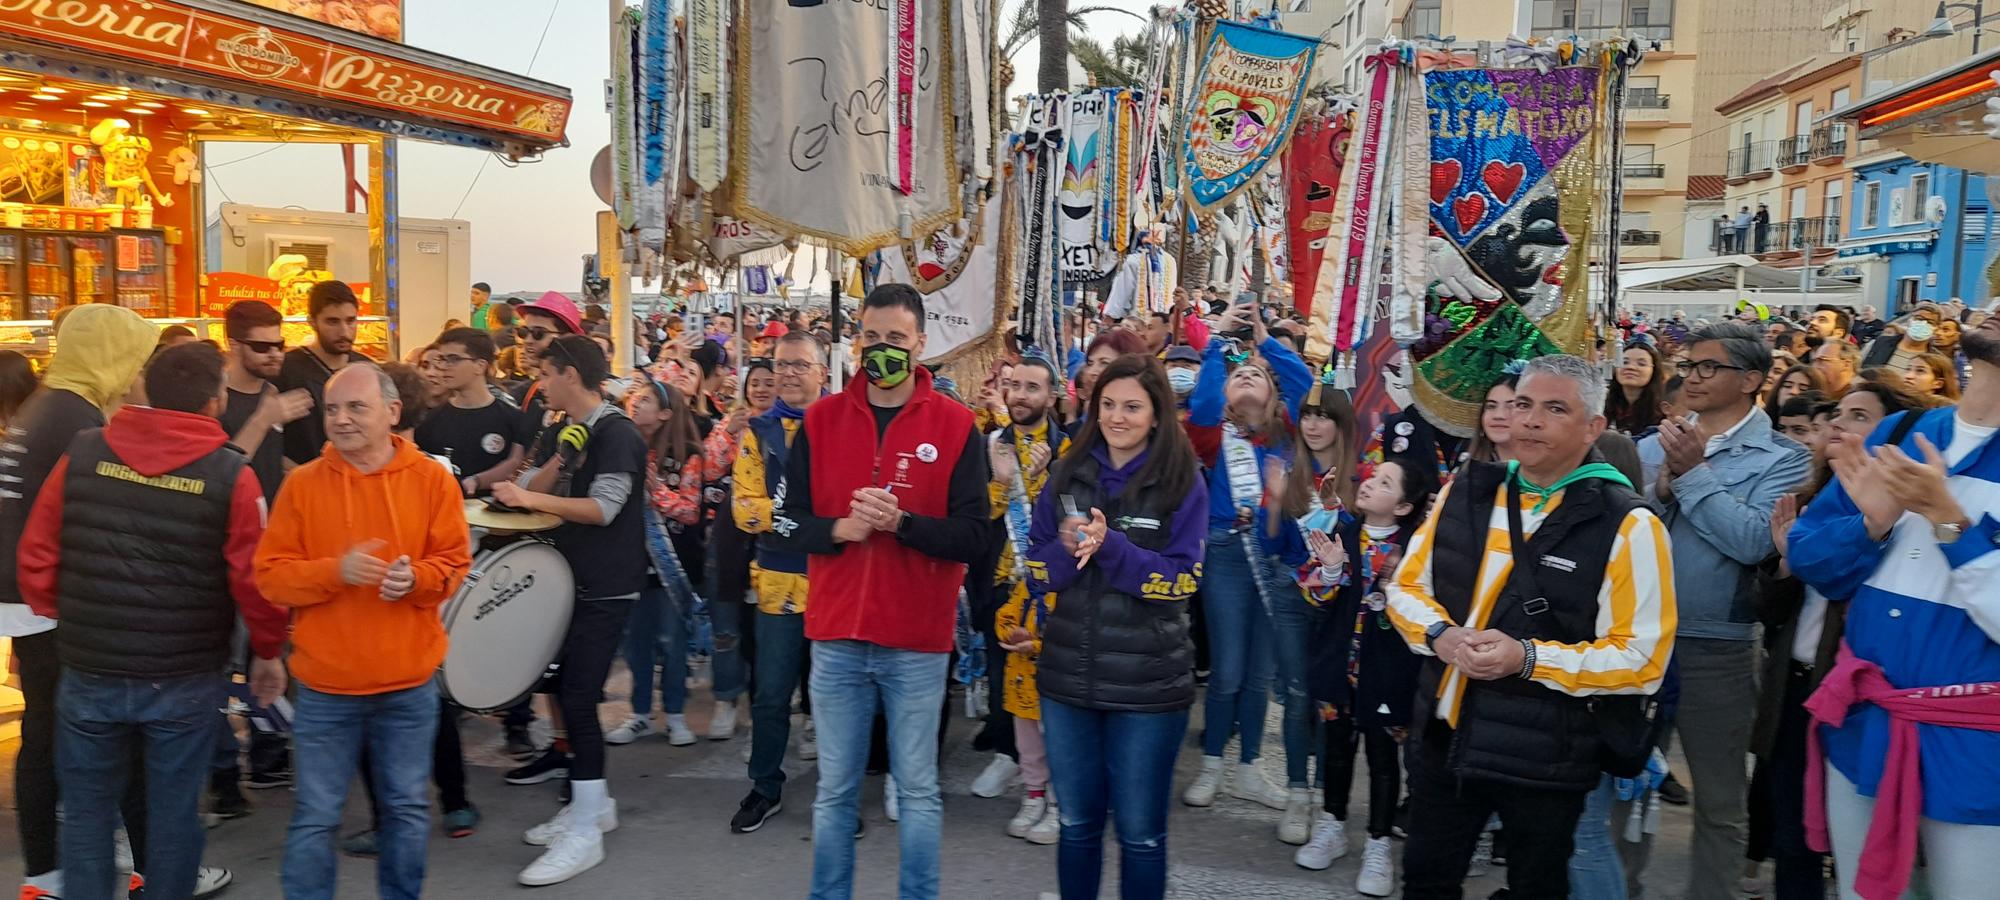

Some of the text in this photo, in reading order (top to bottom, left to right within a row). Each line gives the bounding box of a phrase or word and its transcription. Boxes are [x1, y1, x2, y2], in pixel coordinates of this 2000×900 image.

[900, 36, 912, 76] 2019
[325, 55, 505, 115] Pizzeria
[1242, 72, 1284, 88] POVALS
[1351, 208, 1369, 241] 2019
[257, 288, 271, 298] tus
